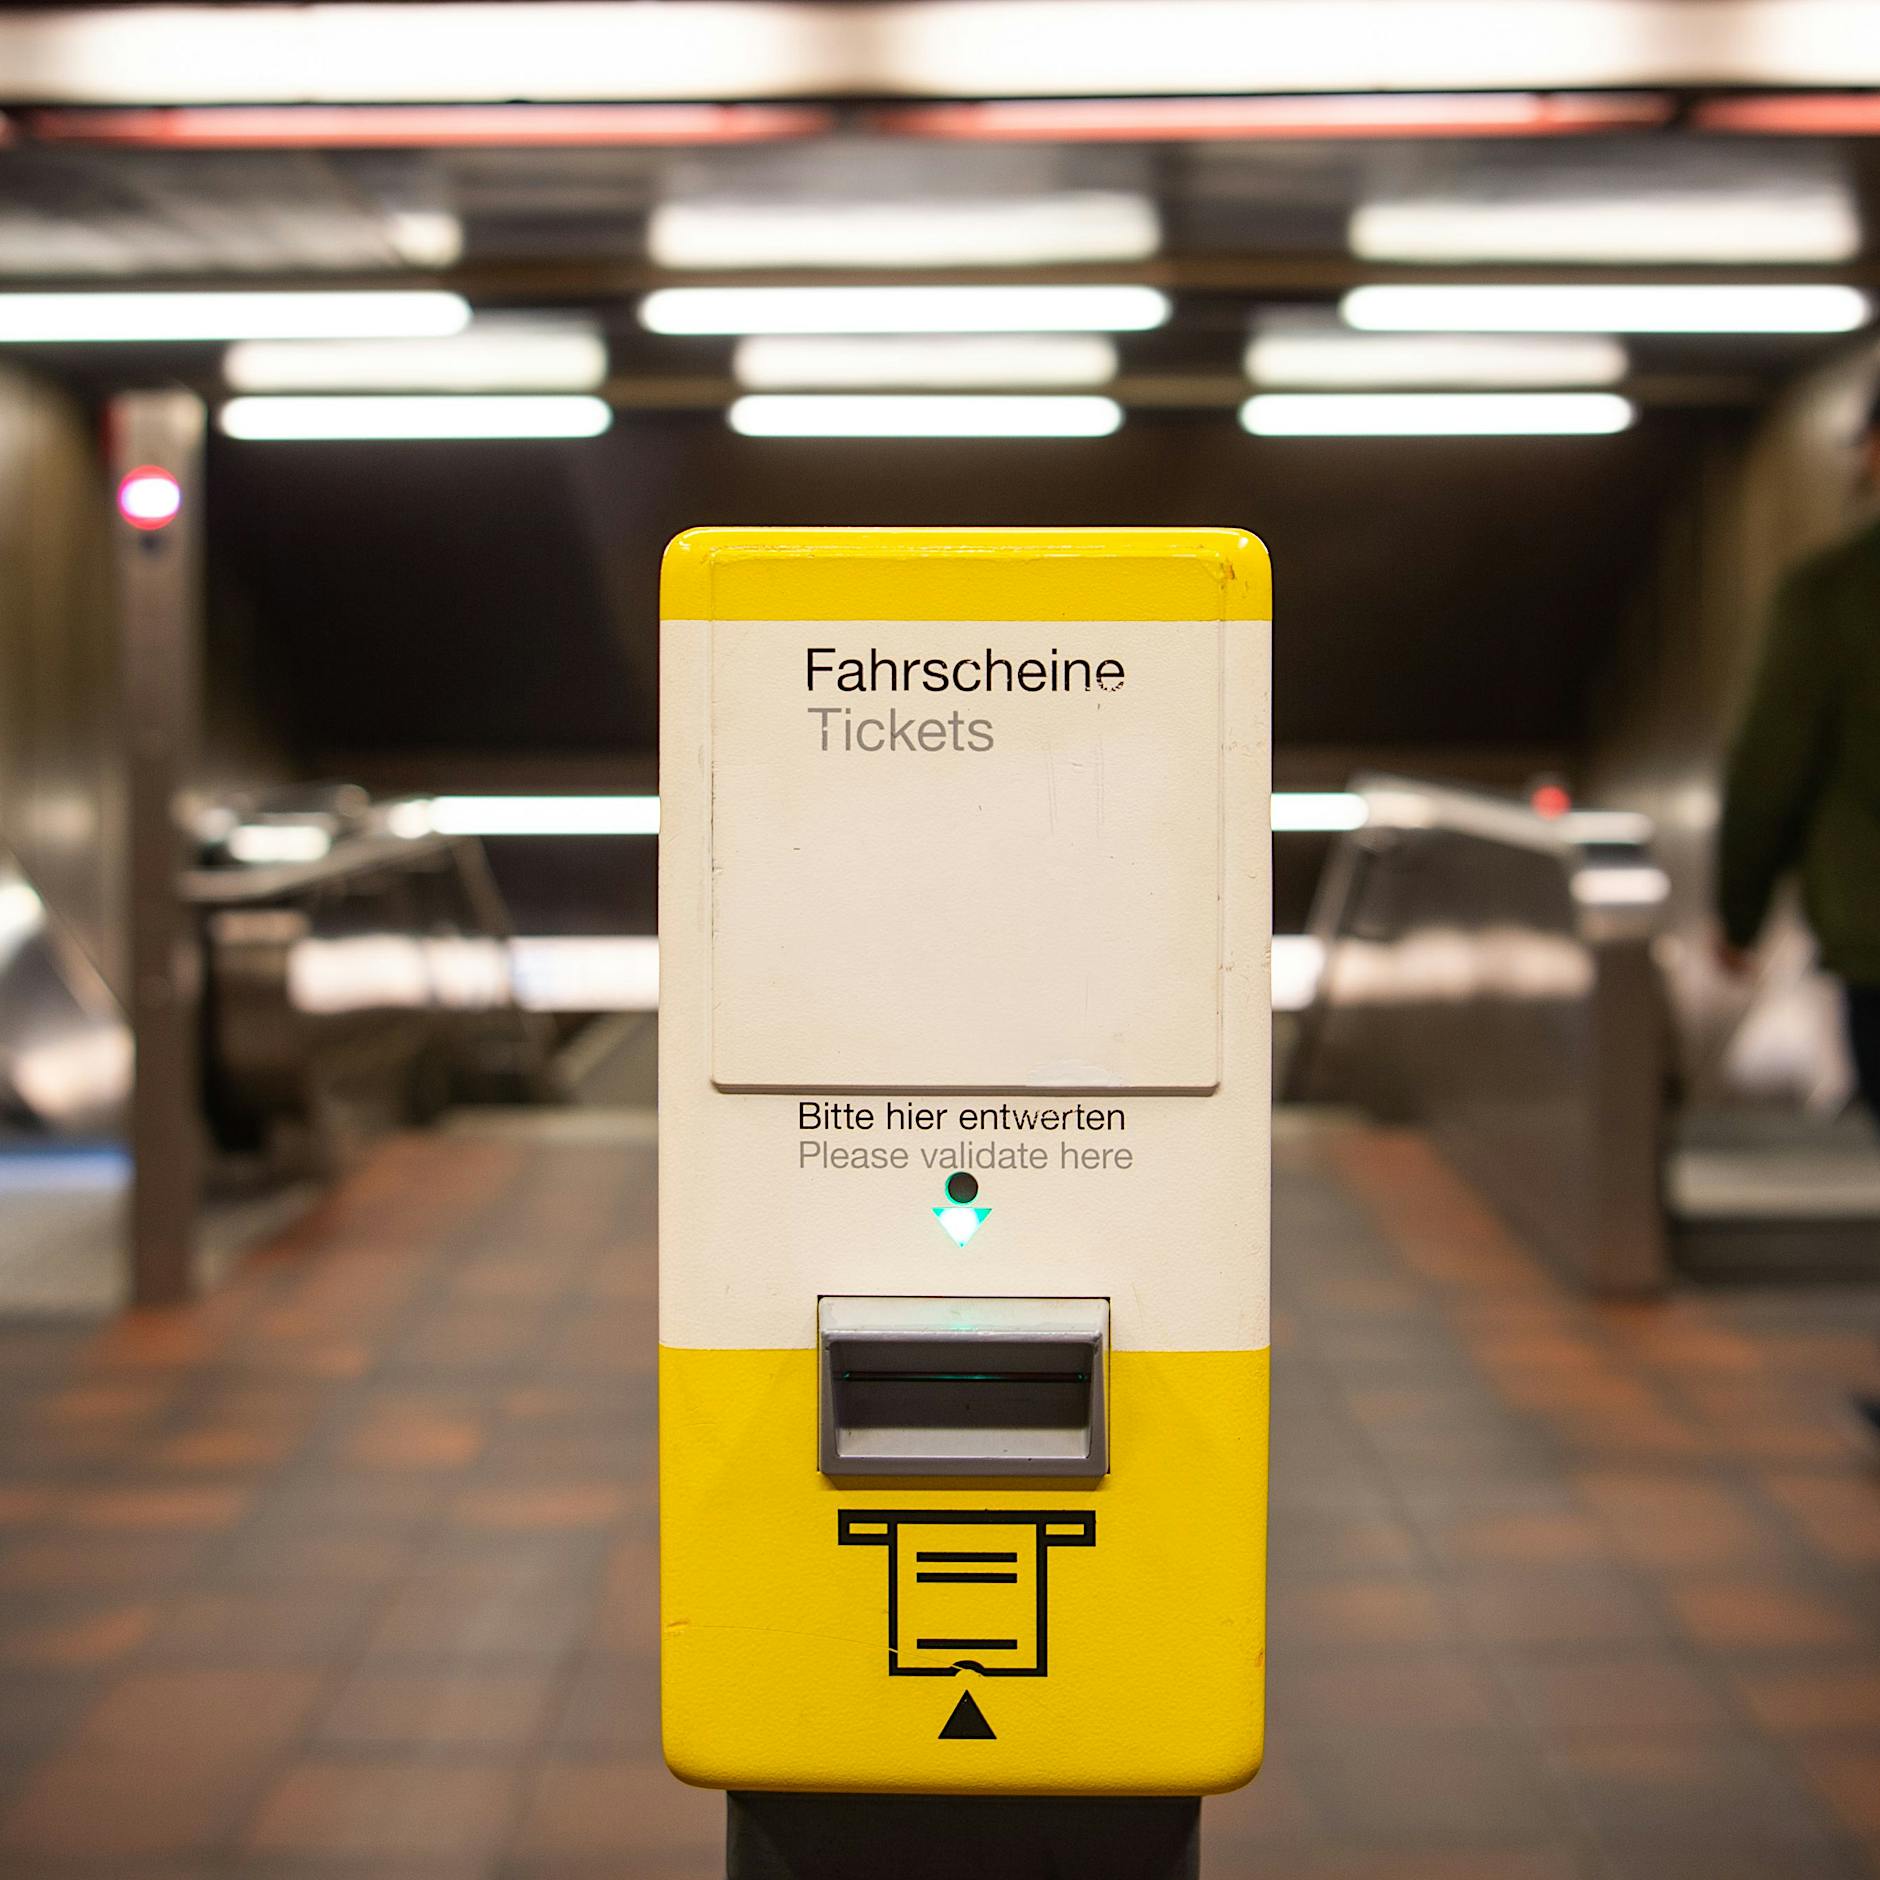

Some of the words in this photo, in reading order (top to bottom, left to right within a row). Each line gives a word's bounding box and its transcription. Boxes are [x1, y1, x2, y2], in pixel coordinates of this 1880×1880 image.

[806, 648, 1125, 692] Fahrscheine
[807, 707, 994, 752] Tickets
[799, 1102, 874, 1130] Bitte
[887, 1102, 948, 1130] hier
[959, 1104, 1125, 1130] entwerten
[799, 1141, 908, 1169] Please
[921, 1141, 1048, 1169] validate
[1061, 1141, 1133, 1169] here
